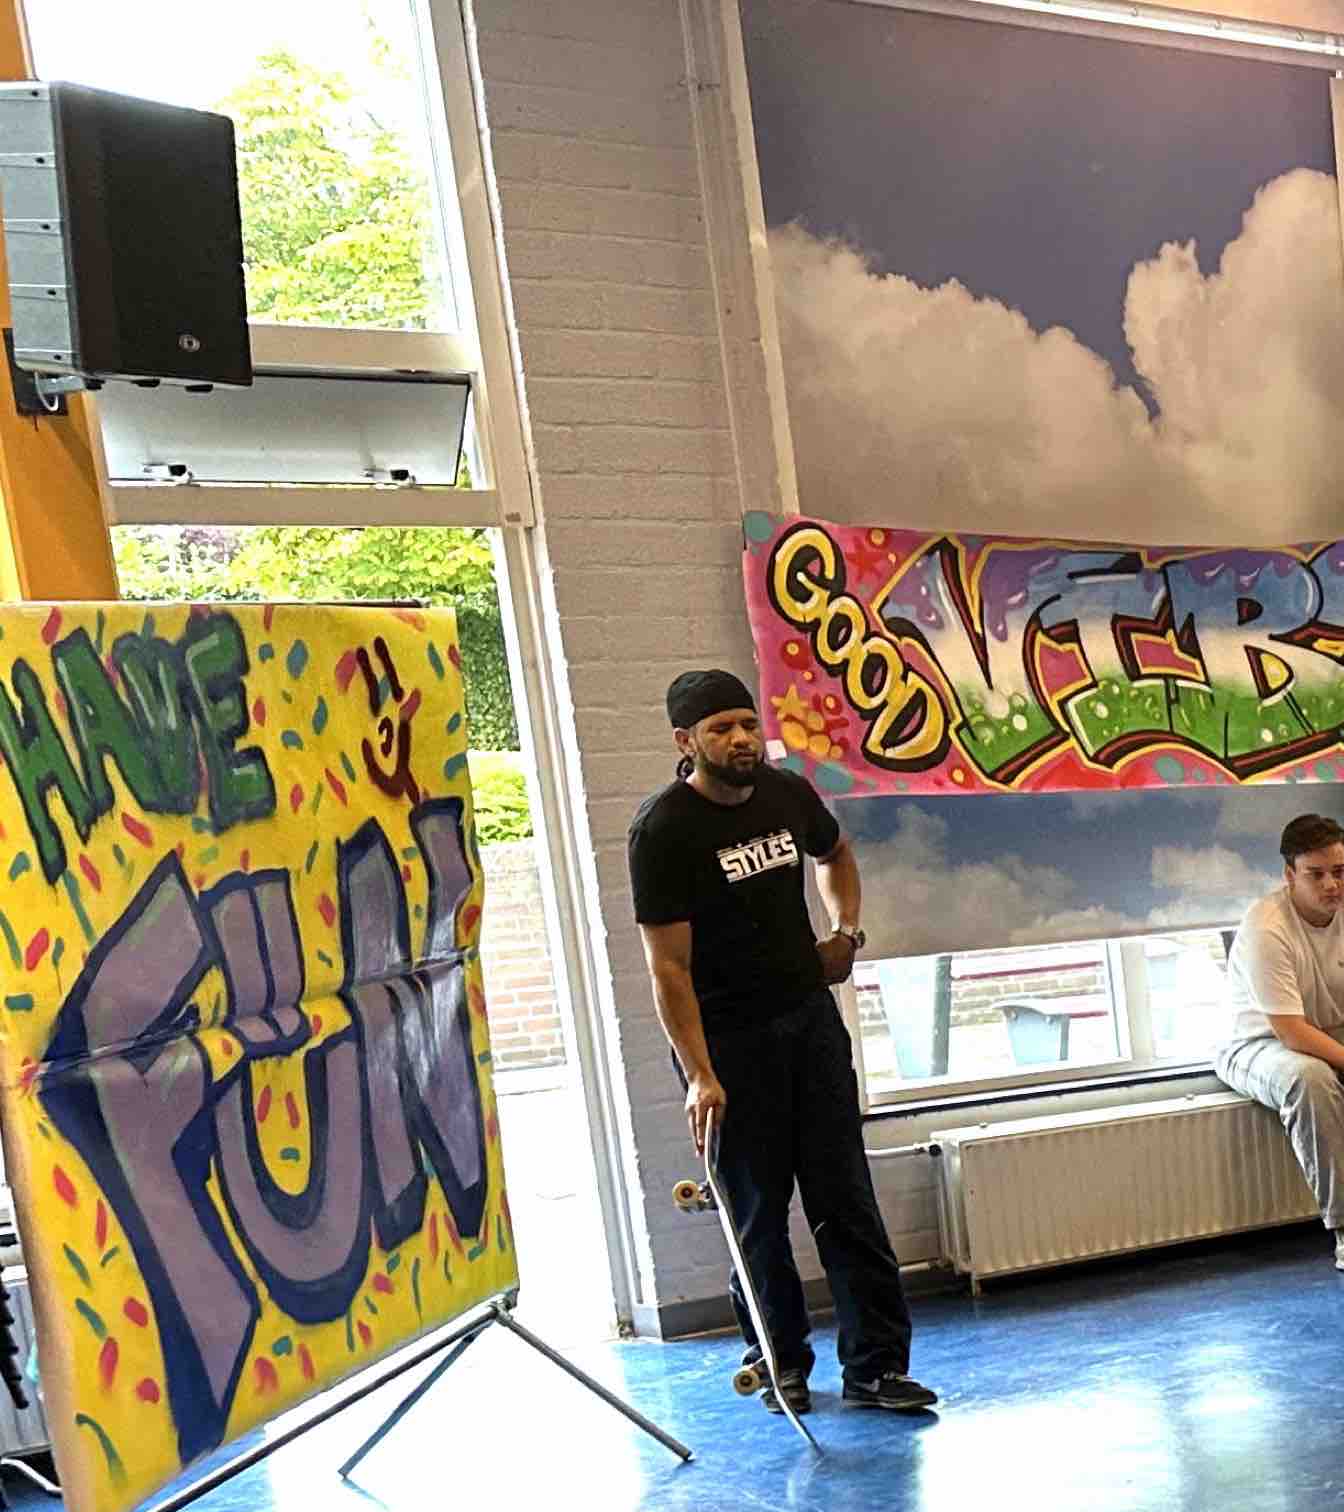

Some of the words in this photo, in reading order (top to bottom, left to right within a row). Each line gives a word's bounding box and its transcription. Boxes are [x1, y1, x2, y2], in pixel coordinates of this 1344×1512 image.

[0, 608, 277, 886] HAVE
[766, 520, 950, 773] GOOD
[716, 831, 799, 883] STYLES
[38, 796, 488, 1465] FUN
